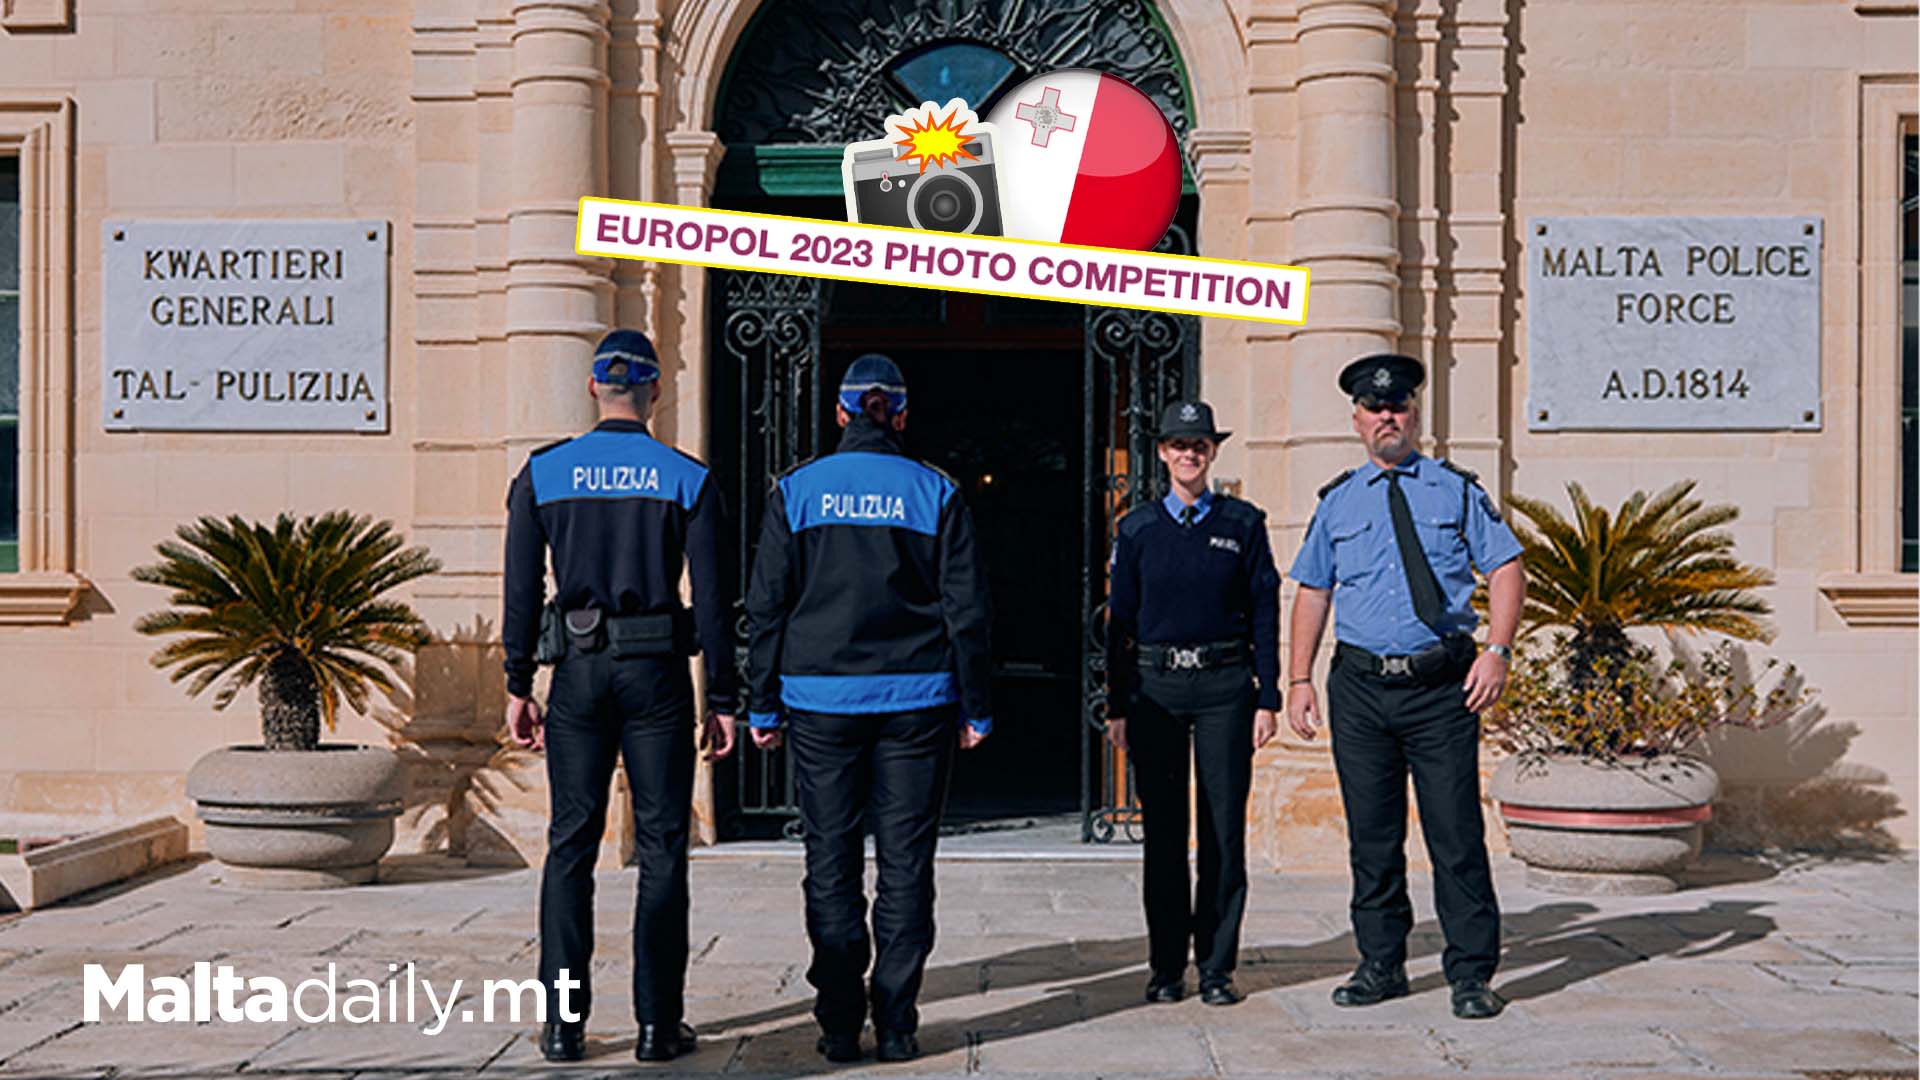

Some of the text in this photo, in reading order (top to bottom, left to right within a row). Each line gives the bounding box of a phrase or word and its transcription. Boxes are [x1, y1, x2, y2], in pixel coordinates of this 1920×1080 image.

[144, 249, 344, 280] KWARTIERI
[1541, 245, 1811, 277] MALTA POLICE
[151, 295, 335, 327] GENERALI
[1616, 292, 1736, 324] FORCE
[112, 369, 375, 402] TAL- PULIZIJA
[1602, 368, 1750, 400] A.D.1814
[573, 466, 659, 491] PULIZIJA
[821, 493, 905, 520] PULIZIJA
